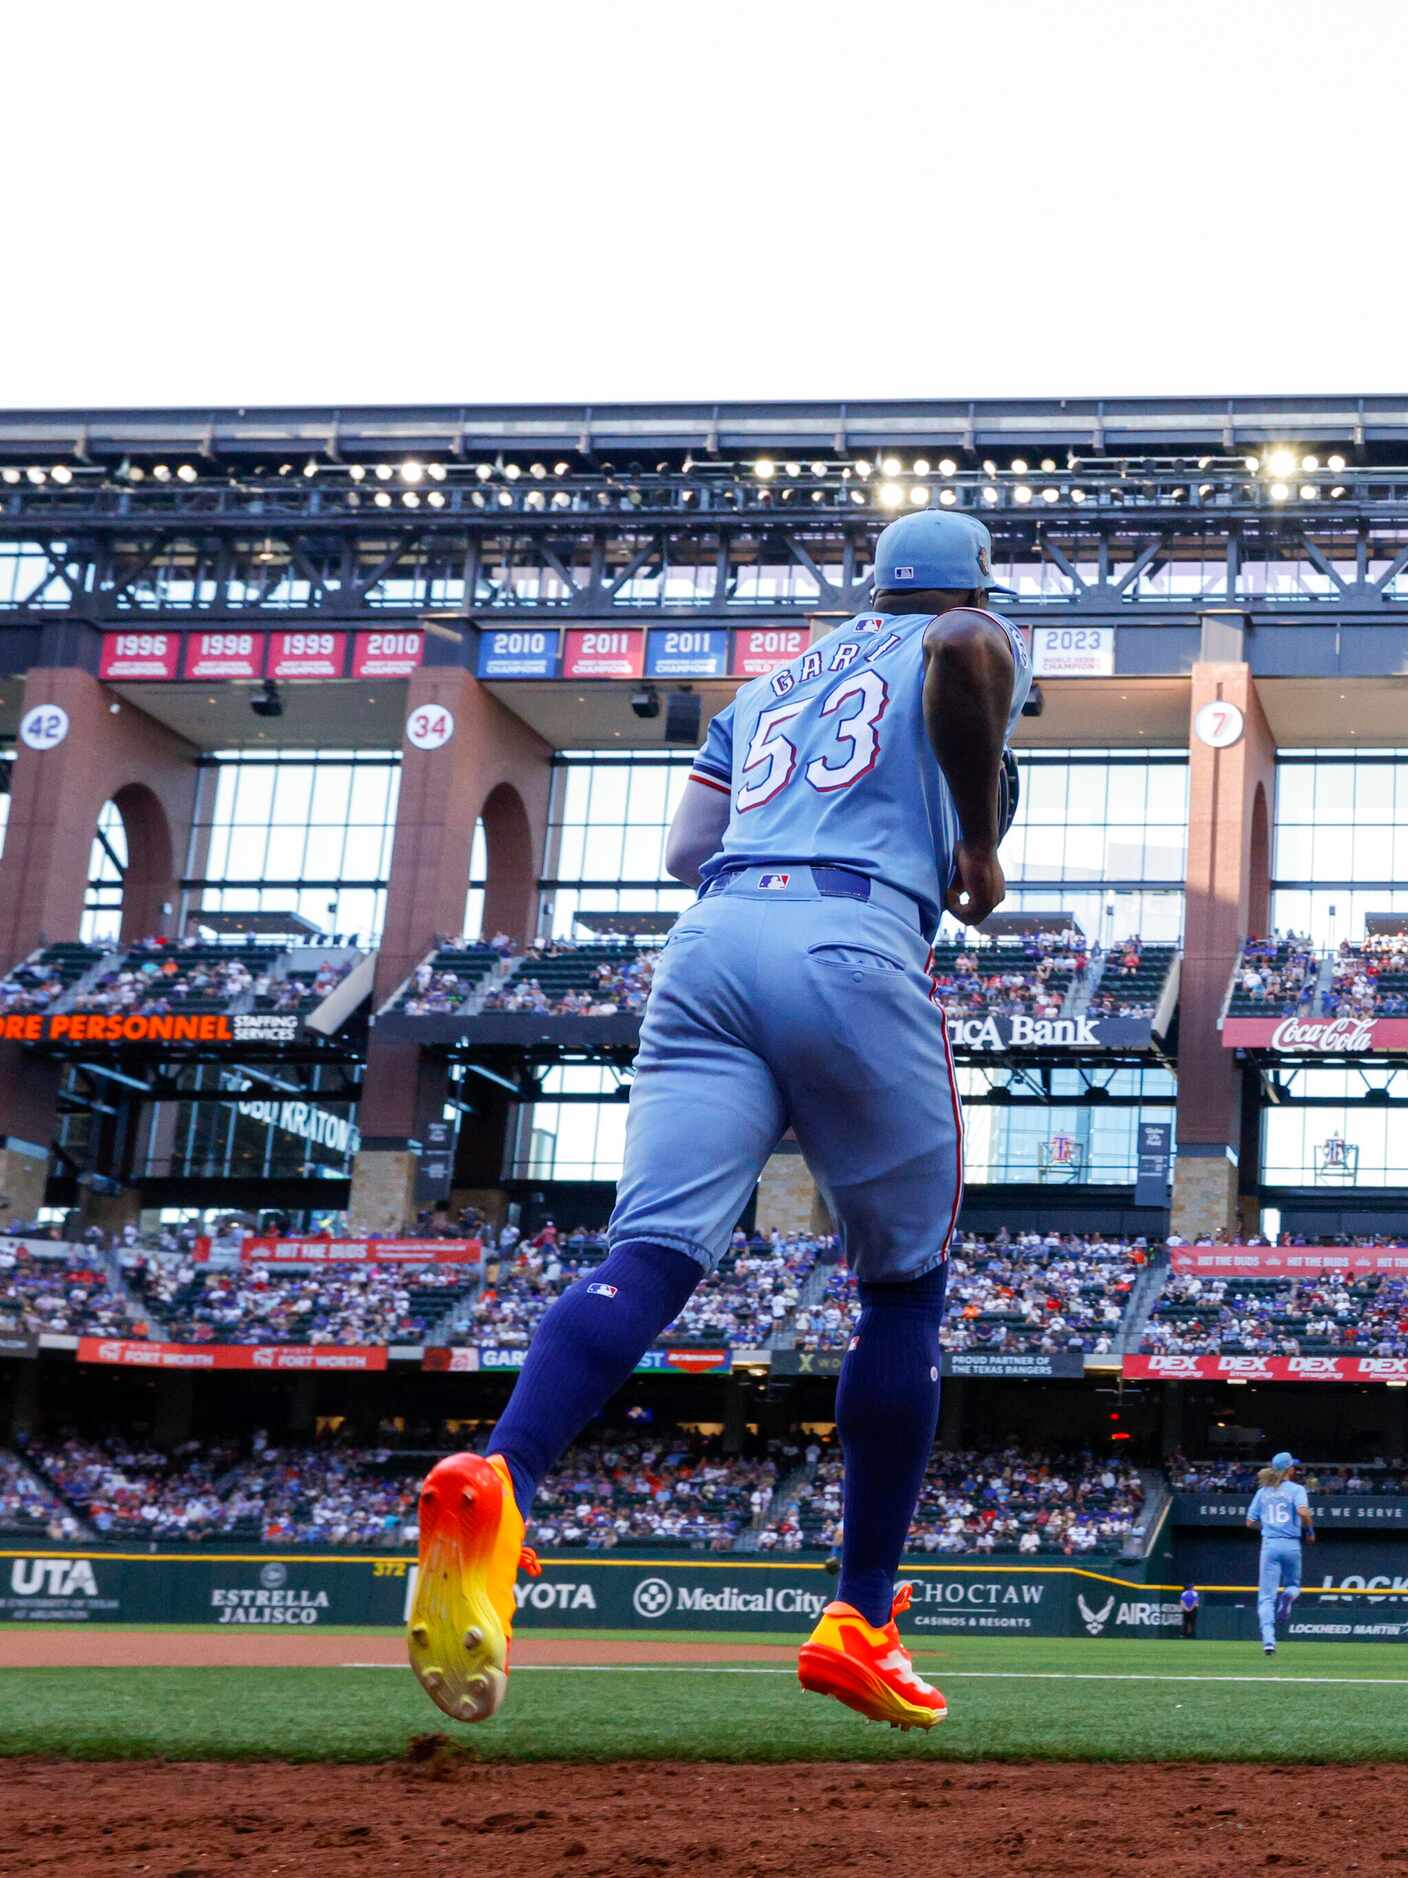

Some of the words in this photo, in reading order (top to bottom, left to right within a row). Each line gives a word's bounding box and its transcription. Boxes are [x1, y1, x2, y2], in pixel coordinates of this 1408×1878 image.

[115, 634, 168, 656] 1996
[201, 634, 253, 656] 1998
[283, 634, 335, 656] 1999
[367, 634, 420, 656] 2010
[493, 633, 545, 654] 2010
[581, 633, 629, 655] 2011
[664, 633, 711, 653] 2011
[749, 632, 801, 653] 2012
[1046, 631, 1102, 650] 2023
[28, 715, 61, 739] 42
[414, 715, 446, 740] 34
[1212, 712, 1228, 737] 7
[736, 668, 889, 815] 53
[50, 1015, 232, 1041] PERSONNEL
[234, 1015, 298, 1028] STAFFING
[1008, 1014, 1100, 1046] Bank
[234, 1028, 296, 1041] SERVICES
[1148, 1356, 1199, 1370] DEX
[1218, 1357, 1269, 1371] DEX
[1288, 1357, 1338, 1371] DEX
[1358, 1358, 1408, 1372] DEX
[1200, 1506, 1248, 1515] ENSUR
[1331, 1508, 1351, 1517] WE
[1358, 1508, 1402, 1518] SERVE
[1265, 1503, 1290, 1524] 16
[11, 1559, 98, 1596] UTA
[373, 1563, 405, 1577] 372
[211, 1589, 329, 1607] ESTRELLA
[513, 1583, 597, 1609] YOTA
[218, 1608, 318, 1624] JALISCO
[914, 1615, 971, 1627] CASINOS
[975, 1616, 984, 1627] &
[987, 1616, 1031, 1628] RESORTS
[1115, 1602, 1151, 1625] AIR
[1289, 1624, 1351, 1634] LOCKHEED
[1352, 1624, 1400, 1635] MARTIN
